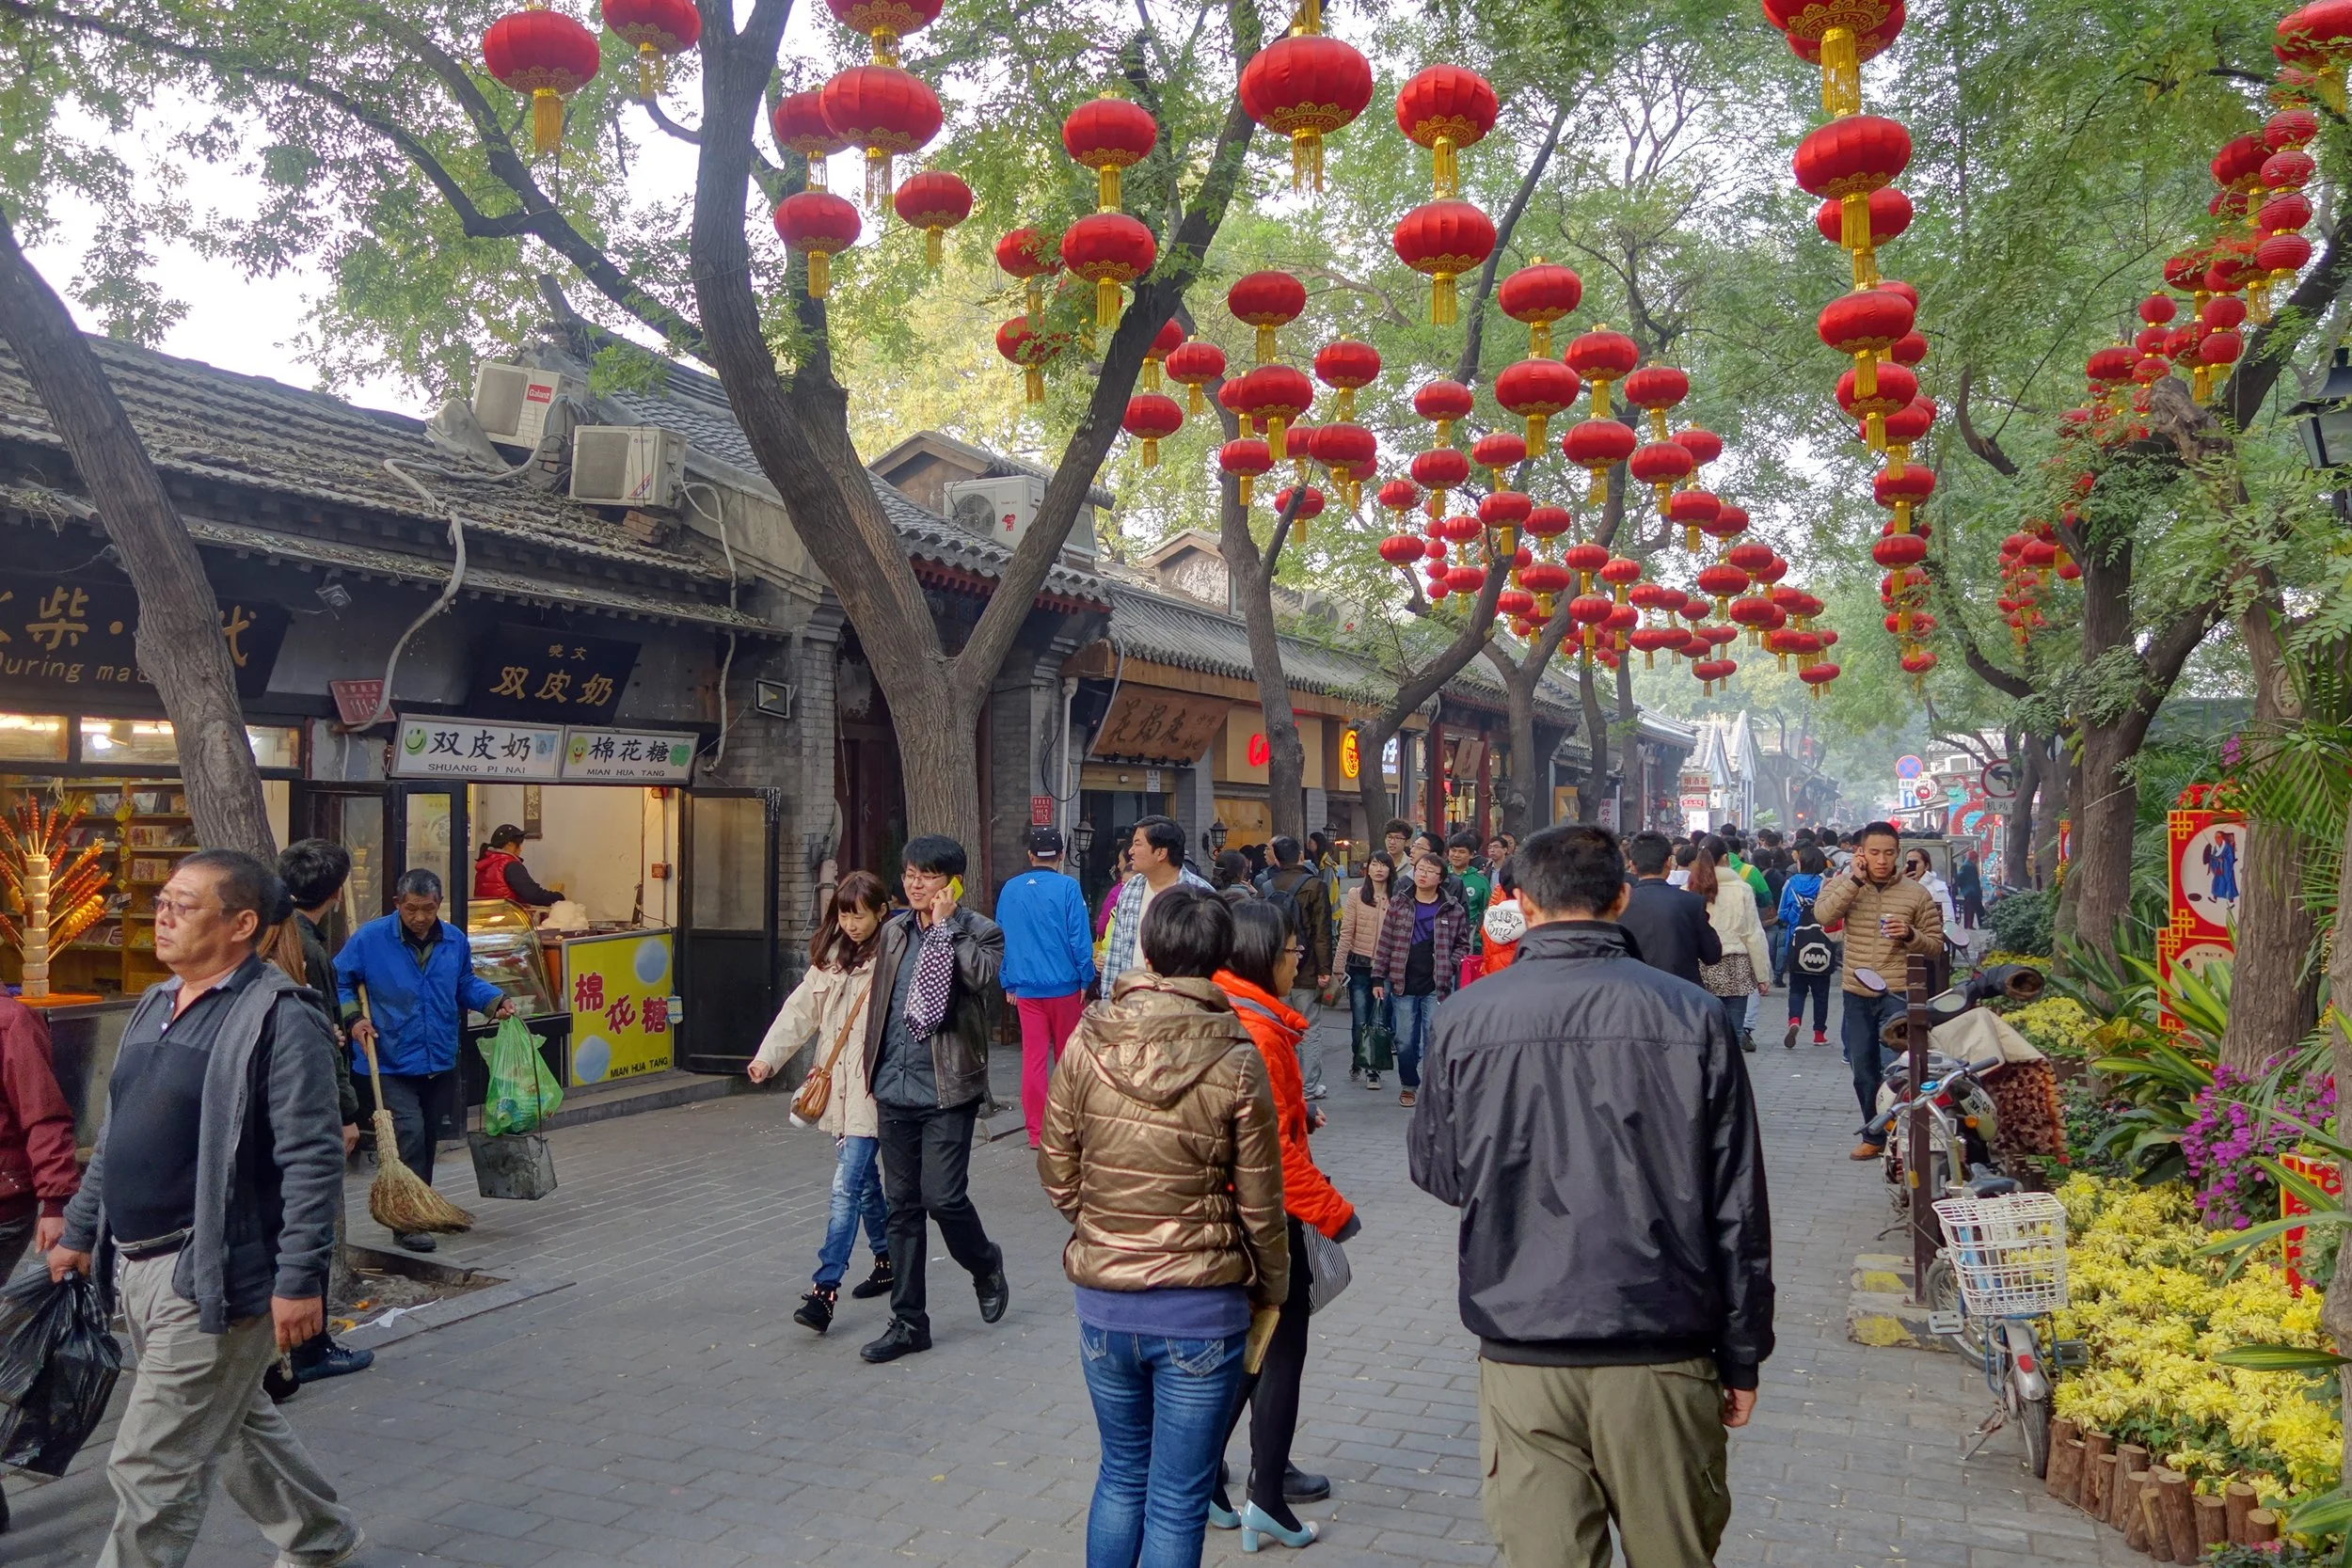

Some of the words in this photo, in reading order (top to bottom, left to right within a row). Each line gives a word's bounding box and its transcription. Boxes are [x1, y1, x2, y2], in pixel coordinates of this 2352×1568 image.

[529, 388, 550, 399] Galanz
[0, 652, 85, 683] uring
[489, 666, 613, 706] 双皮奶
[428, 729, 532, 762] 双皮奶
[588, 736, 670, 763] 棉花糖
[428, 763, 478, 772] SHUANG
[487, 765, 498, 773] PI
[505, 766, 526, 774] NAI
[574, 972, 668, 1035] 棉花糖
[610, 1067, 628, 1078] MIAN
[631, 1062, 646, 1072] HUA
[649, 1056, 668, 1069] TANG
